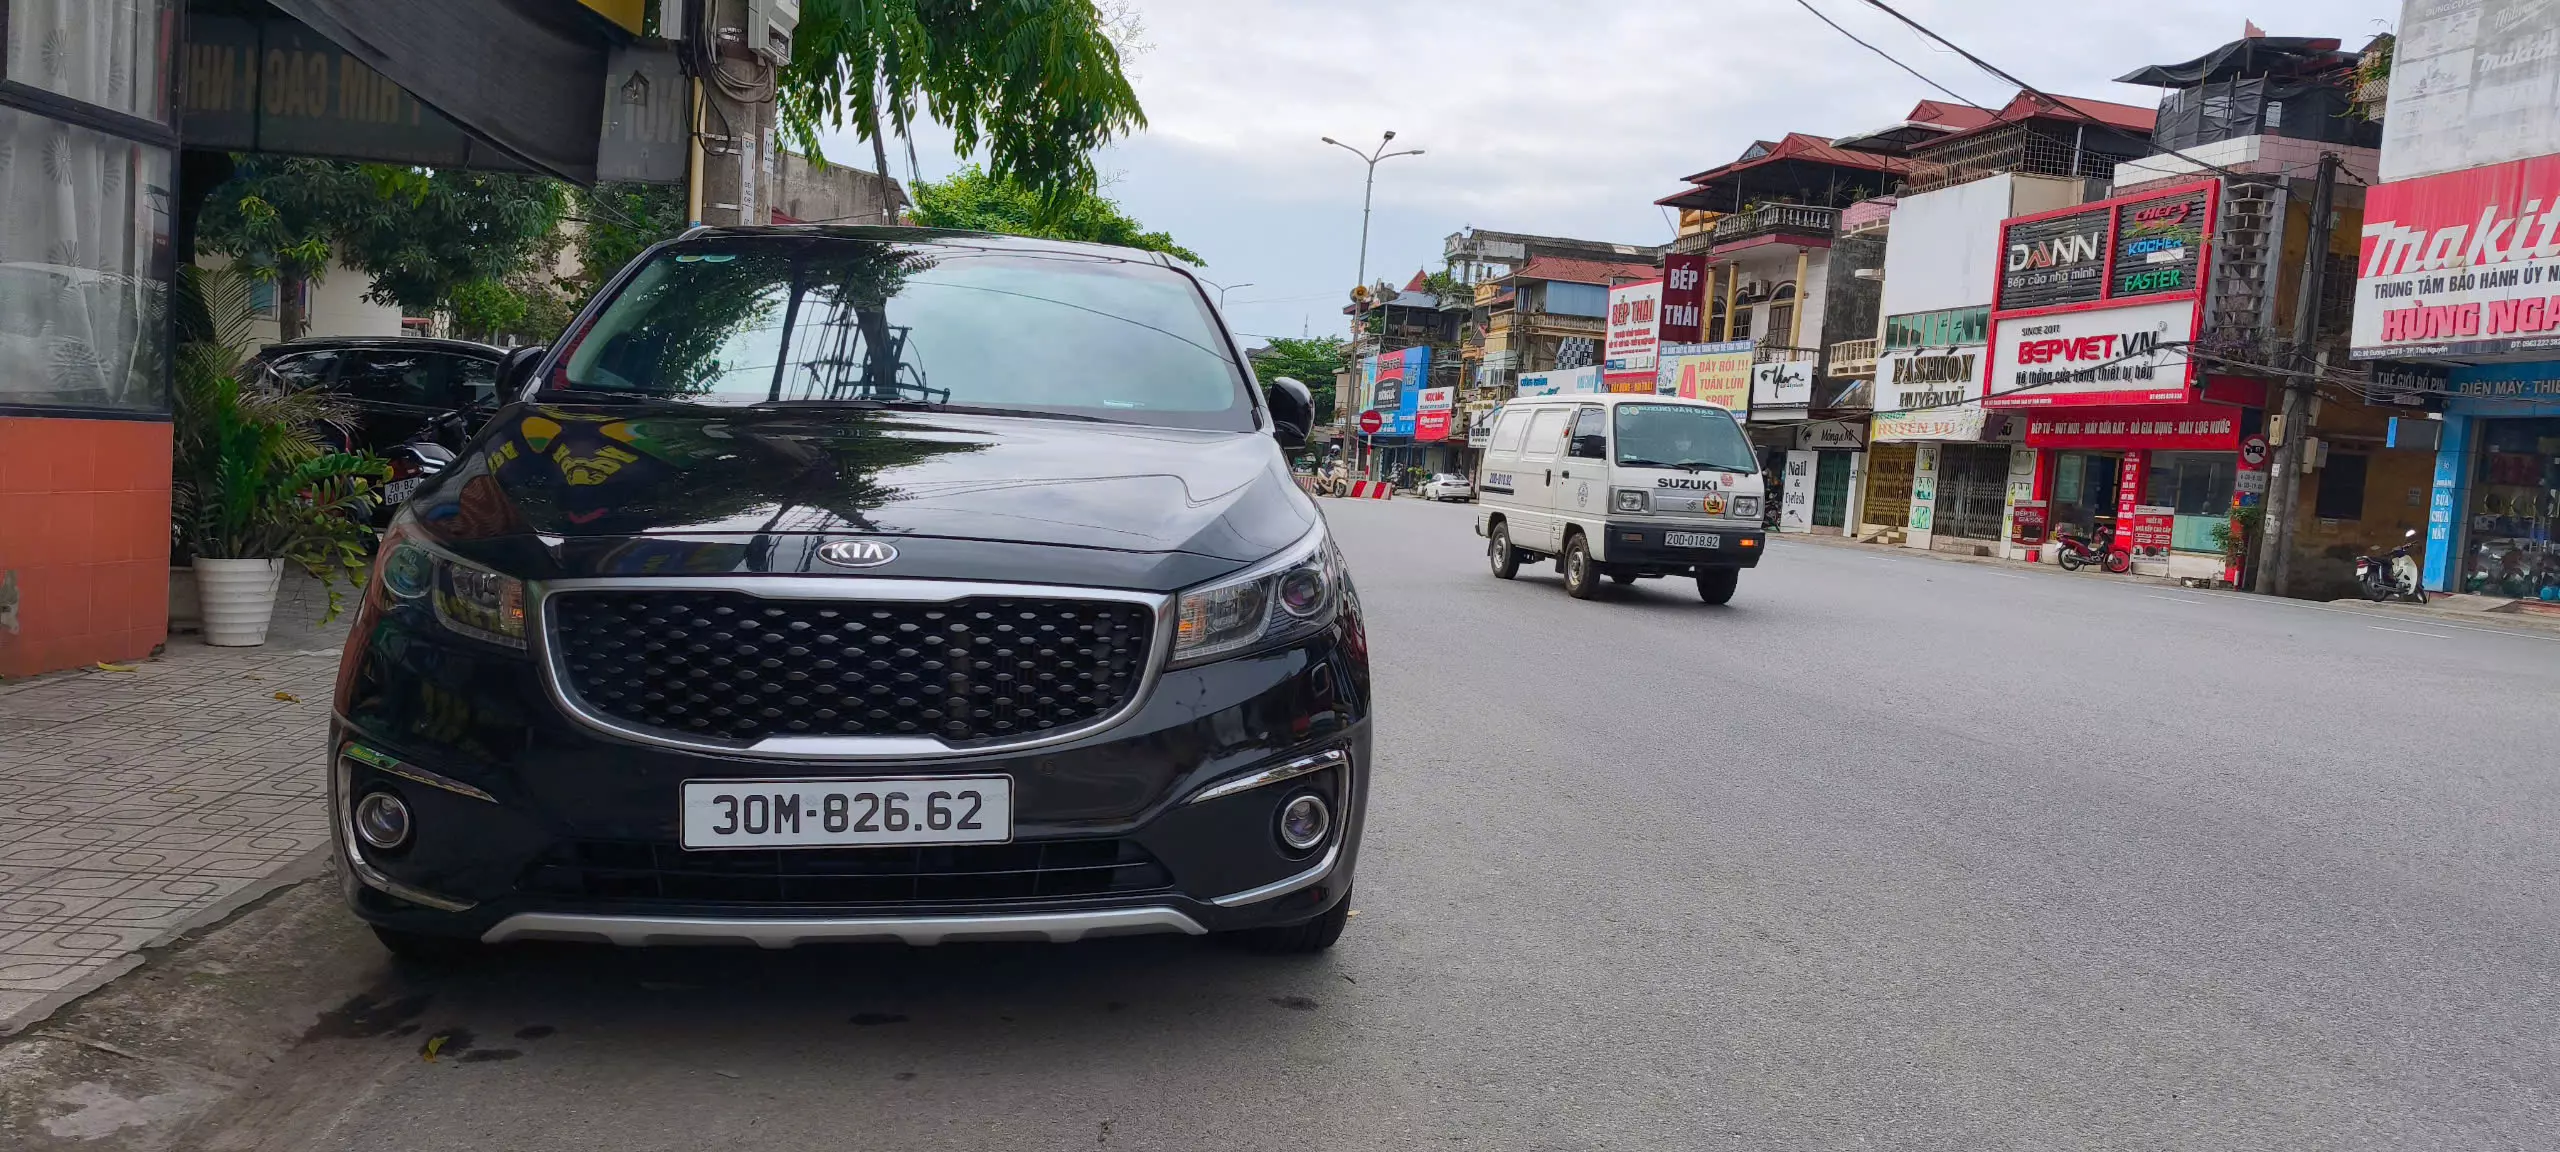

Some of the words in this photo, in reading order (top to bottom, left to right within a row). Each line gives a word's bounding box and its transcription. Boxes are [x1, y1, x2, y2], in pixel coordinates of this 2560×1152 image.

[2008, 231, 2098, 272] DANN
[1669, 261, 1699, 291] BẾP
[2124, 269, 2181, 292] FASTER
[2375, 280, 2413, 300] TRUNG
[2418, 274, 2444, 295] TÂM
[2449, 269, 2475, 292] BẢO
[2479, 268, 2518, 290] HÀNH
[2523, 260, 2543, 285] ỦY
[1612, 294, 1630, 326] BẾP
[1631, 294, 1656, 324] THÁI
[1664, 302, 1699, 328] THÁI
[2381, 299, 2480, 342] HÙNG
[1893, 354, 1976, 384] FASHION
[2431, 377, 2447, 391] PIN
[2495, 377, 2525, 395] MÁY
[1899, 384, 1944, 408] HUYỀN
[1944, 385, 1966, 407] VŨ
[1878, 416, 1929, 436] HUYỀN
[2195, 420, 2209, 435] LỌC
[2209, 418, 2231, 434] NƯỚC
[1788, 460, 1807, 477] Nail
[1657, 478, 1718, 490] SUZUKI
[1794, 478, 1801, 488] &
[1785, 492, 1805, 507] Eyelash
[1666, 533, 1719, 548] 20D-018.92
[830, 542, 884, 561] KIA
[712, 790, 982, 835] 30M-826.62
